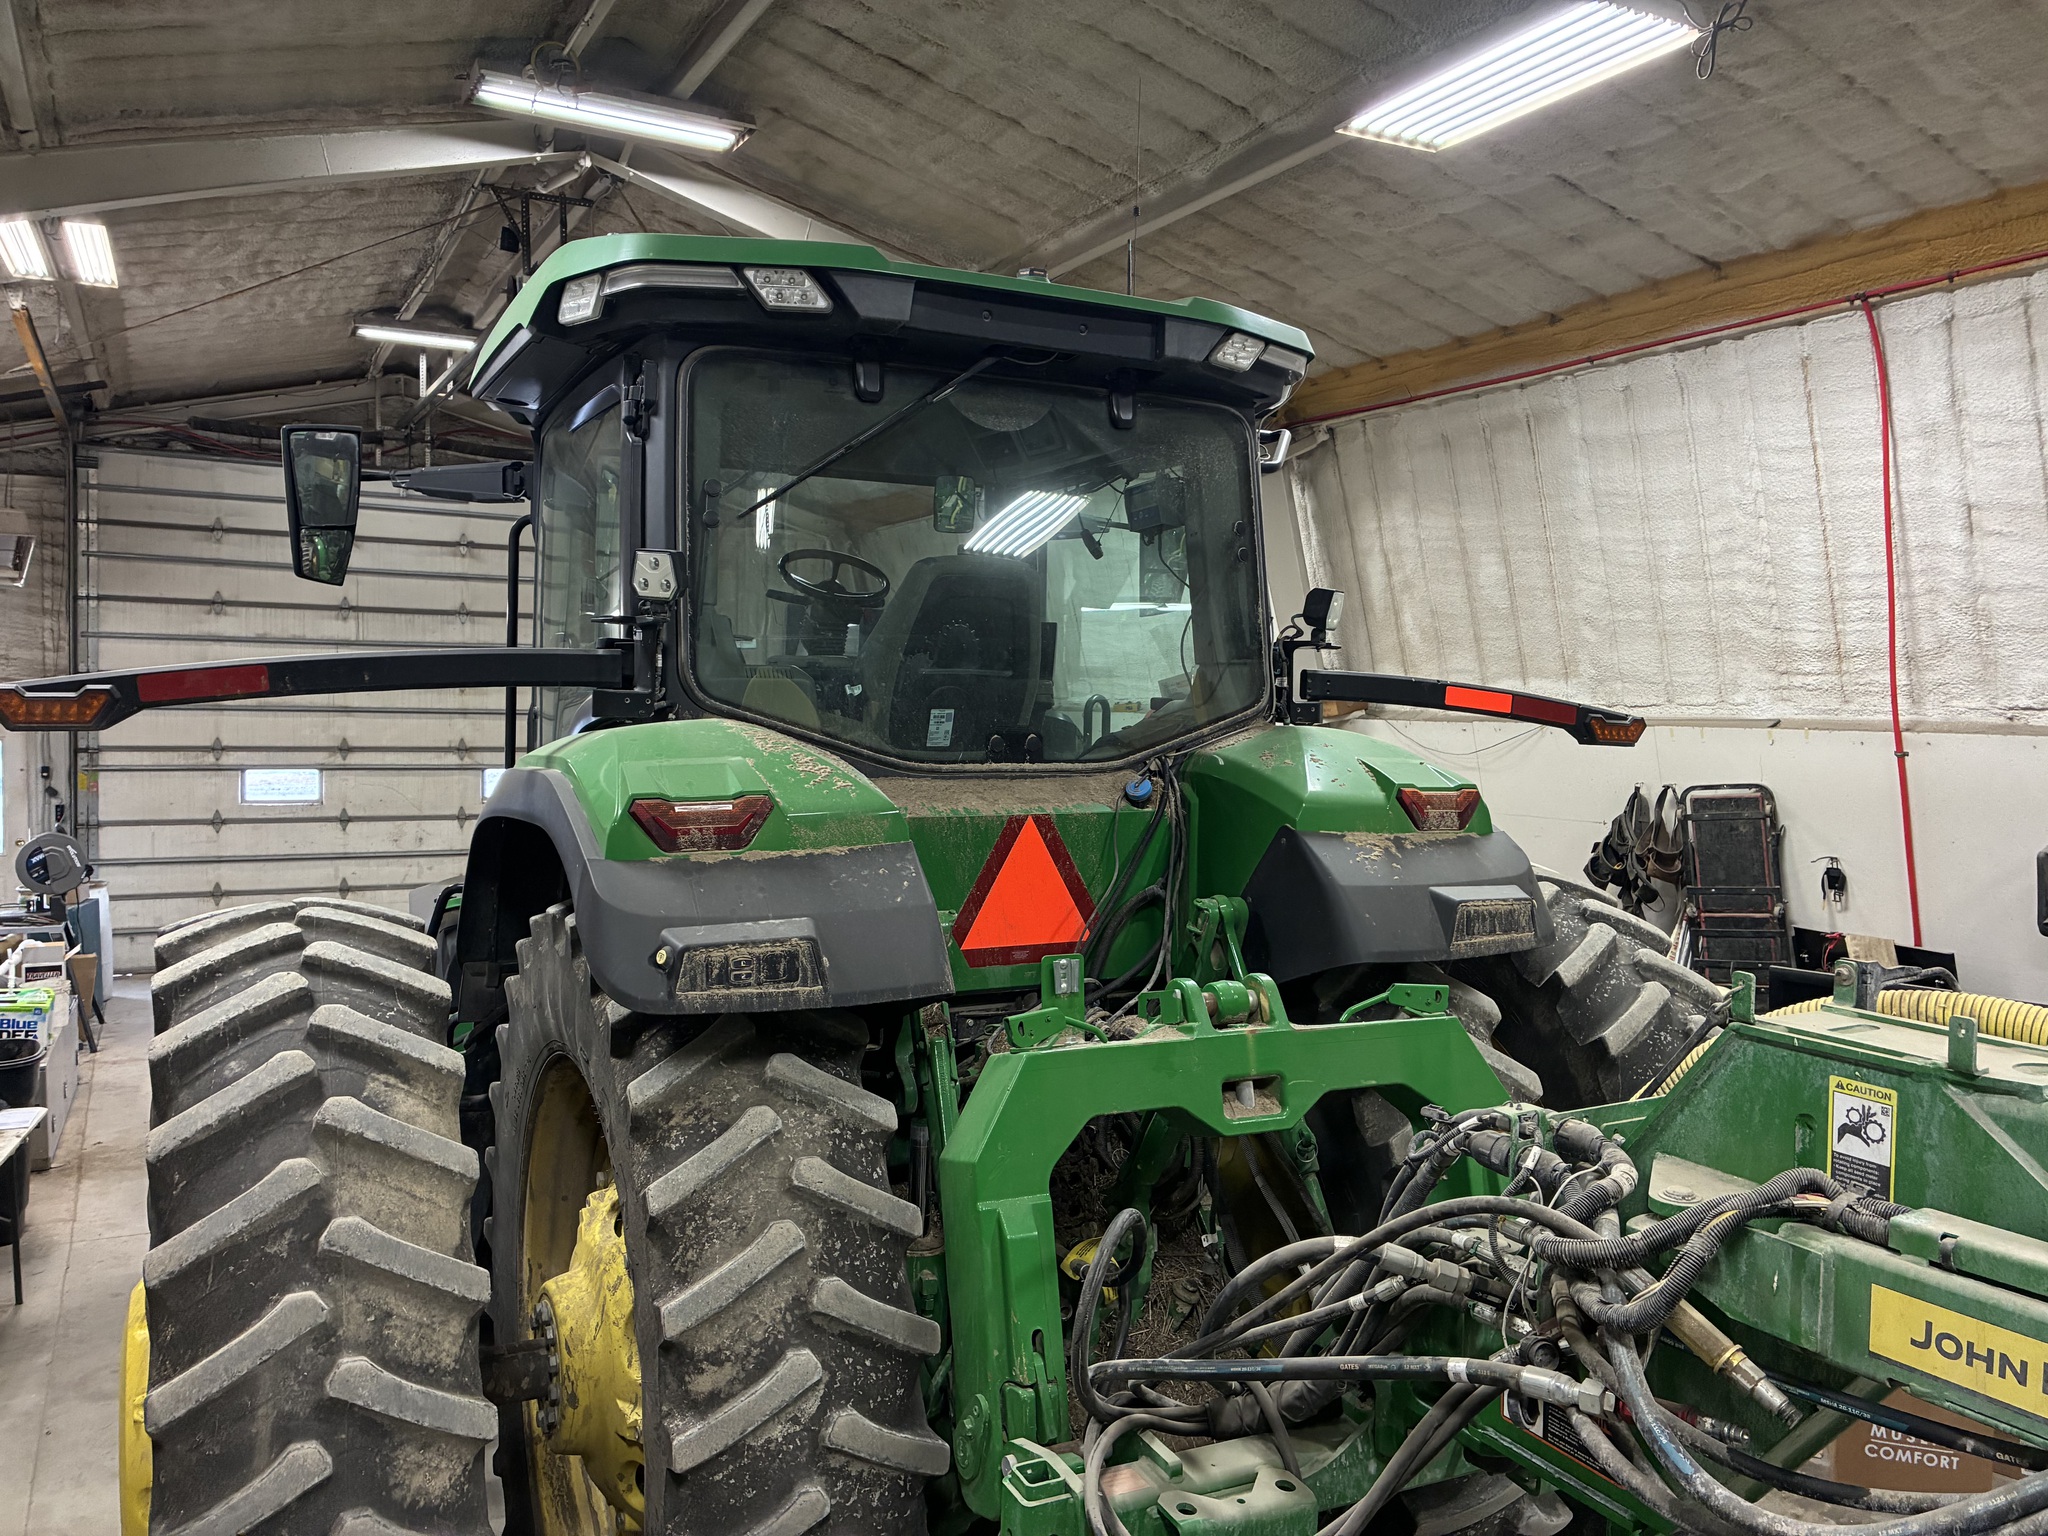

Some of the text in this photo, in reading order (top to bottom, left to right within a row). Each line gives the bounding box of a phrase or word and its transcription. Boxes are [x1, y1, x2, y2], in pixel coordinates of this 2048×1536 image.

[0, 1018, 38, 1029] Blue
[1845, 1083, 1892, 1101] CAUTION
[1910, 1320, 2028, 1387] JOHN
[1864, 1444, 1960, 1470] COMFORT
